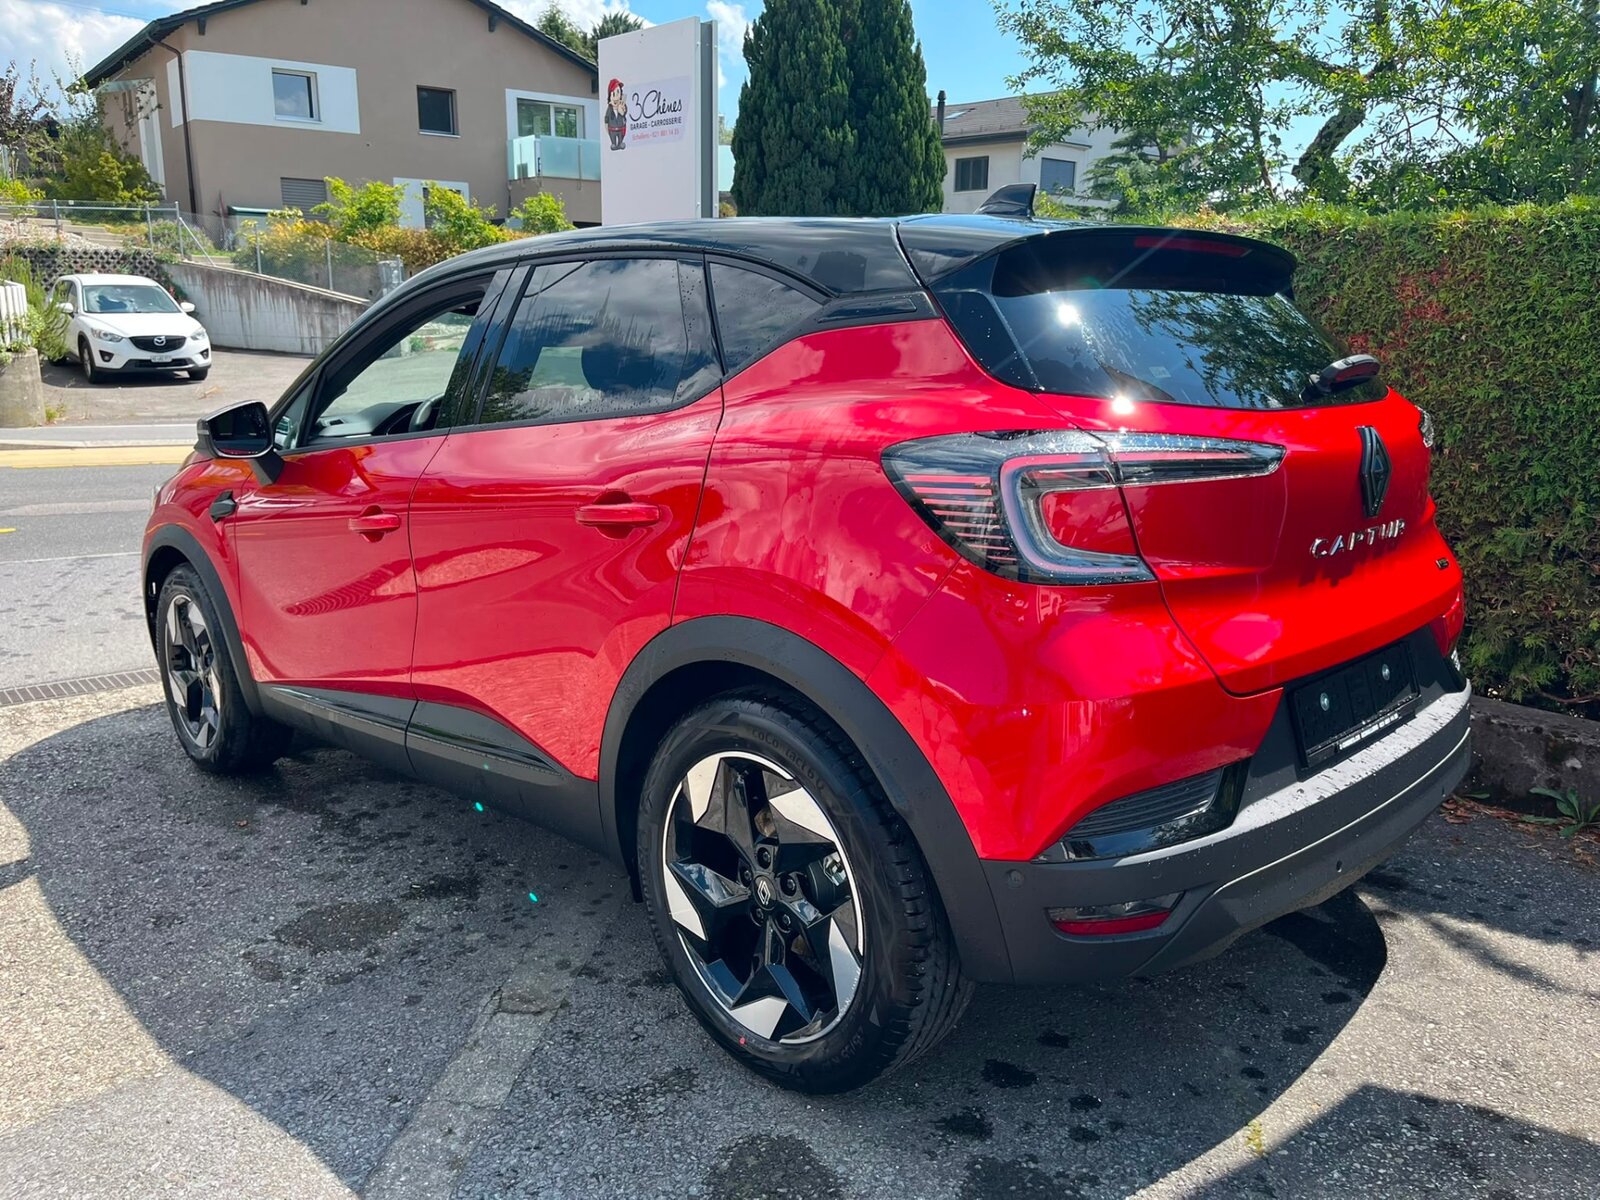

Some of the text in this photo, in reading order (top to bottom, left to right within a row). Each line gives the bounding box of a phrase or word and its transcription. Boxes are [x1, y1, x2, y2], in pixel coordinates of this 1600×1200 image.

[629, 90, 682, 121] 3 Chênes
[630, 121, 648, 130] GARAGE
[651, 116, 682, 128] CARROSSERIE
[1309, 518, 1405, 559] CAPTUR
